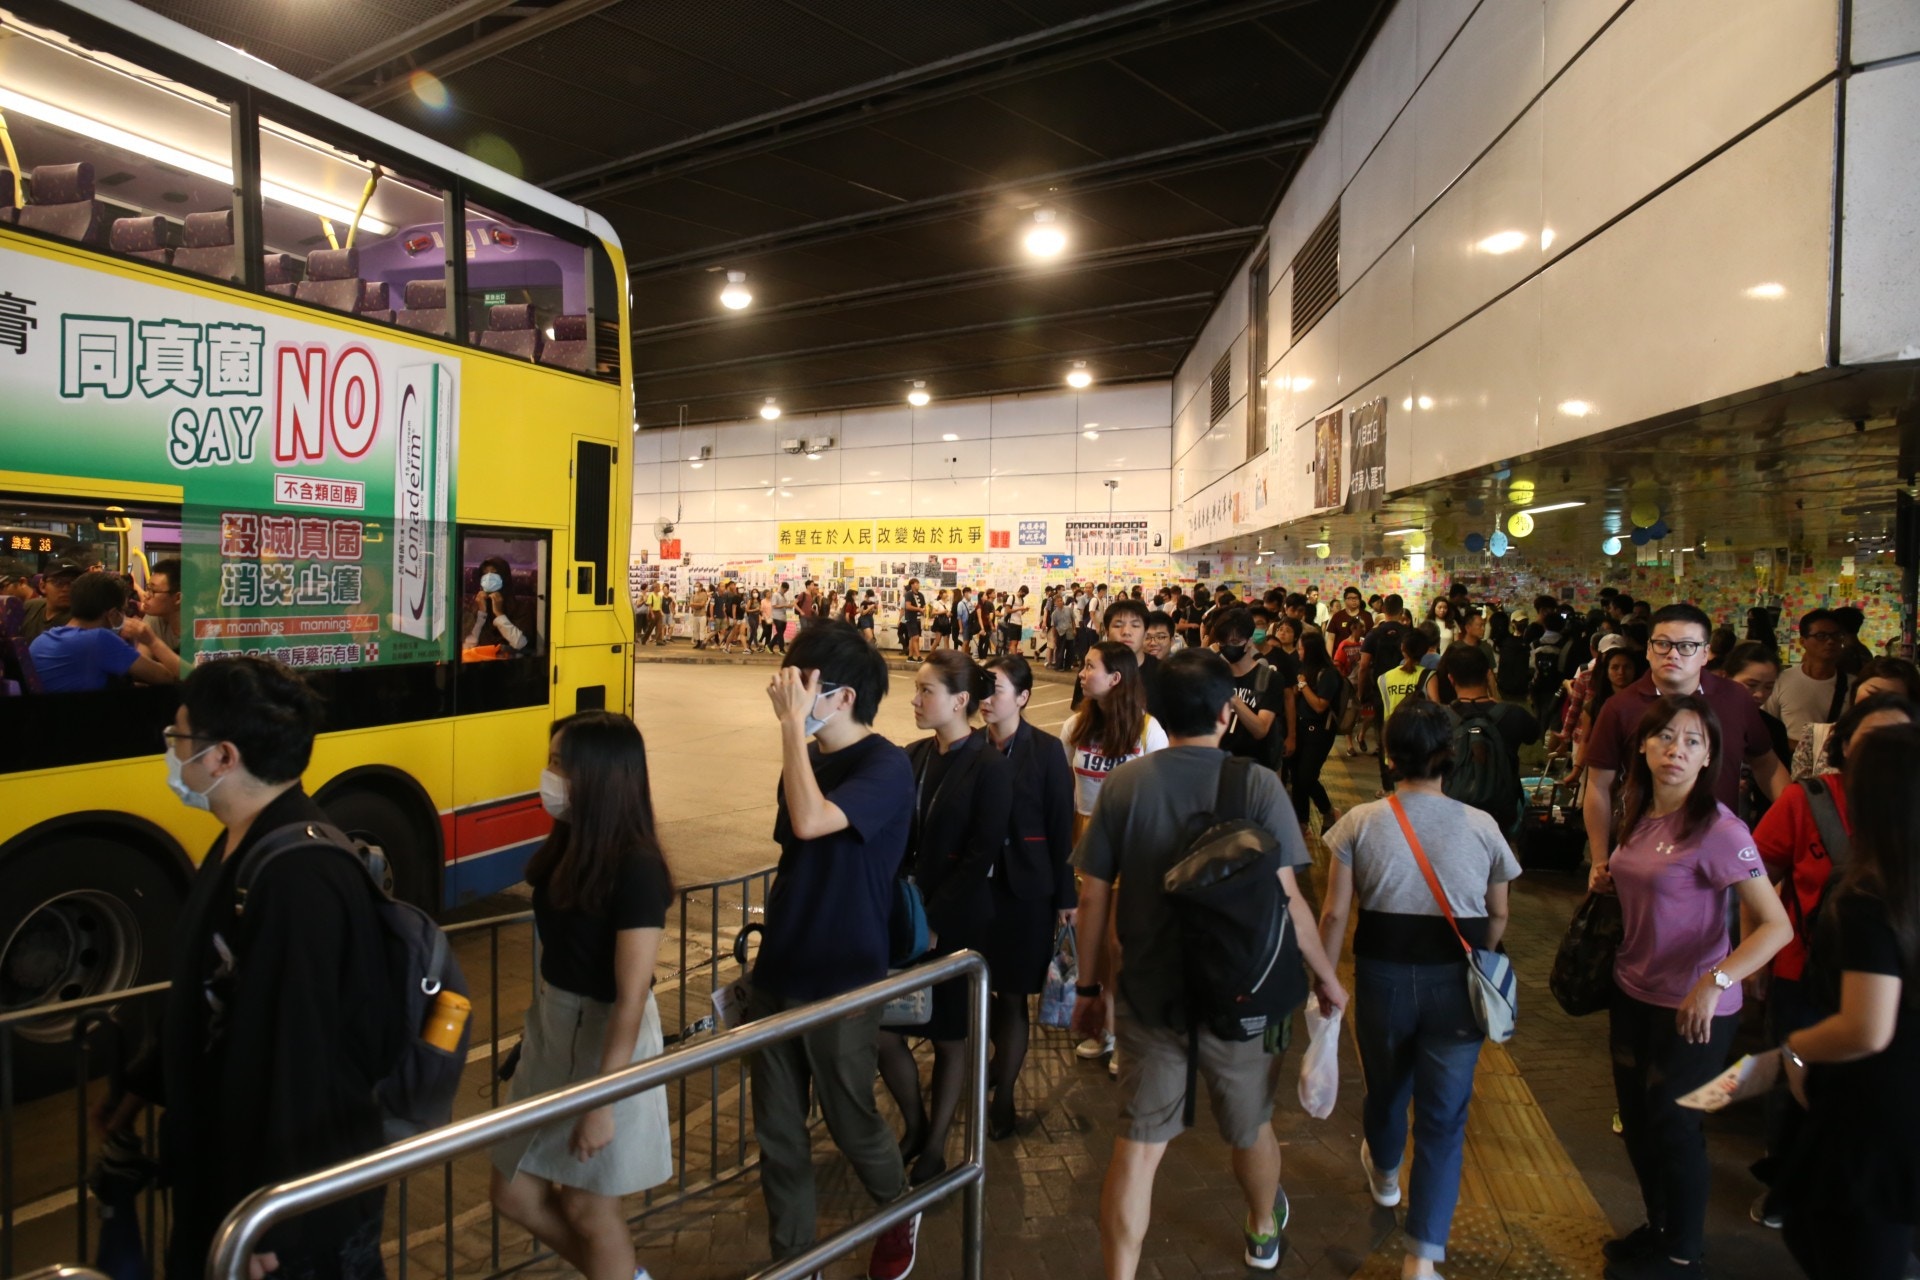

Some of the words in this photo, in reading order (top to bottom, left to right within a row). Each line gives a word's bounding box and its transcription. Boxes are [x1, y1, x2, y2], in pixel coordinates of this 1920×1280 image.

[59, 312, 265, 398] 同真菌
[170, 406, 263, 465] SAY
[274, 345, 381, 462] NO
[1356, 420, 1378, 449] 八月五日
[283, 480, 358, 504] 不含類固醇
[404, 433, 422, 580] Lonaderm
[220, 512, 363, 560] 殺滅真菌
[780, 527, 871, 546] 希望在於人民
[877, 525, 982, 545] 改變始於抗爭
[220, 562, 362, 606] 消炎止癢
[226, 621, 285, 635] mannings
[300, 618, 351, 633] mannings
